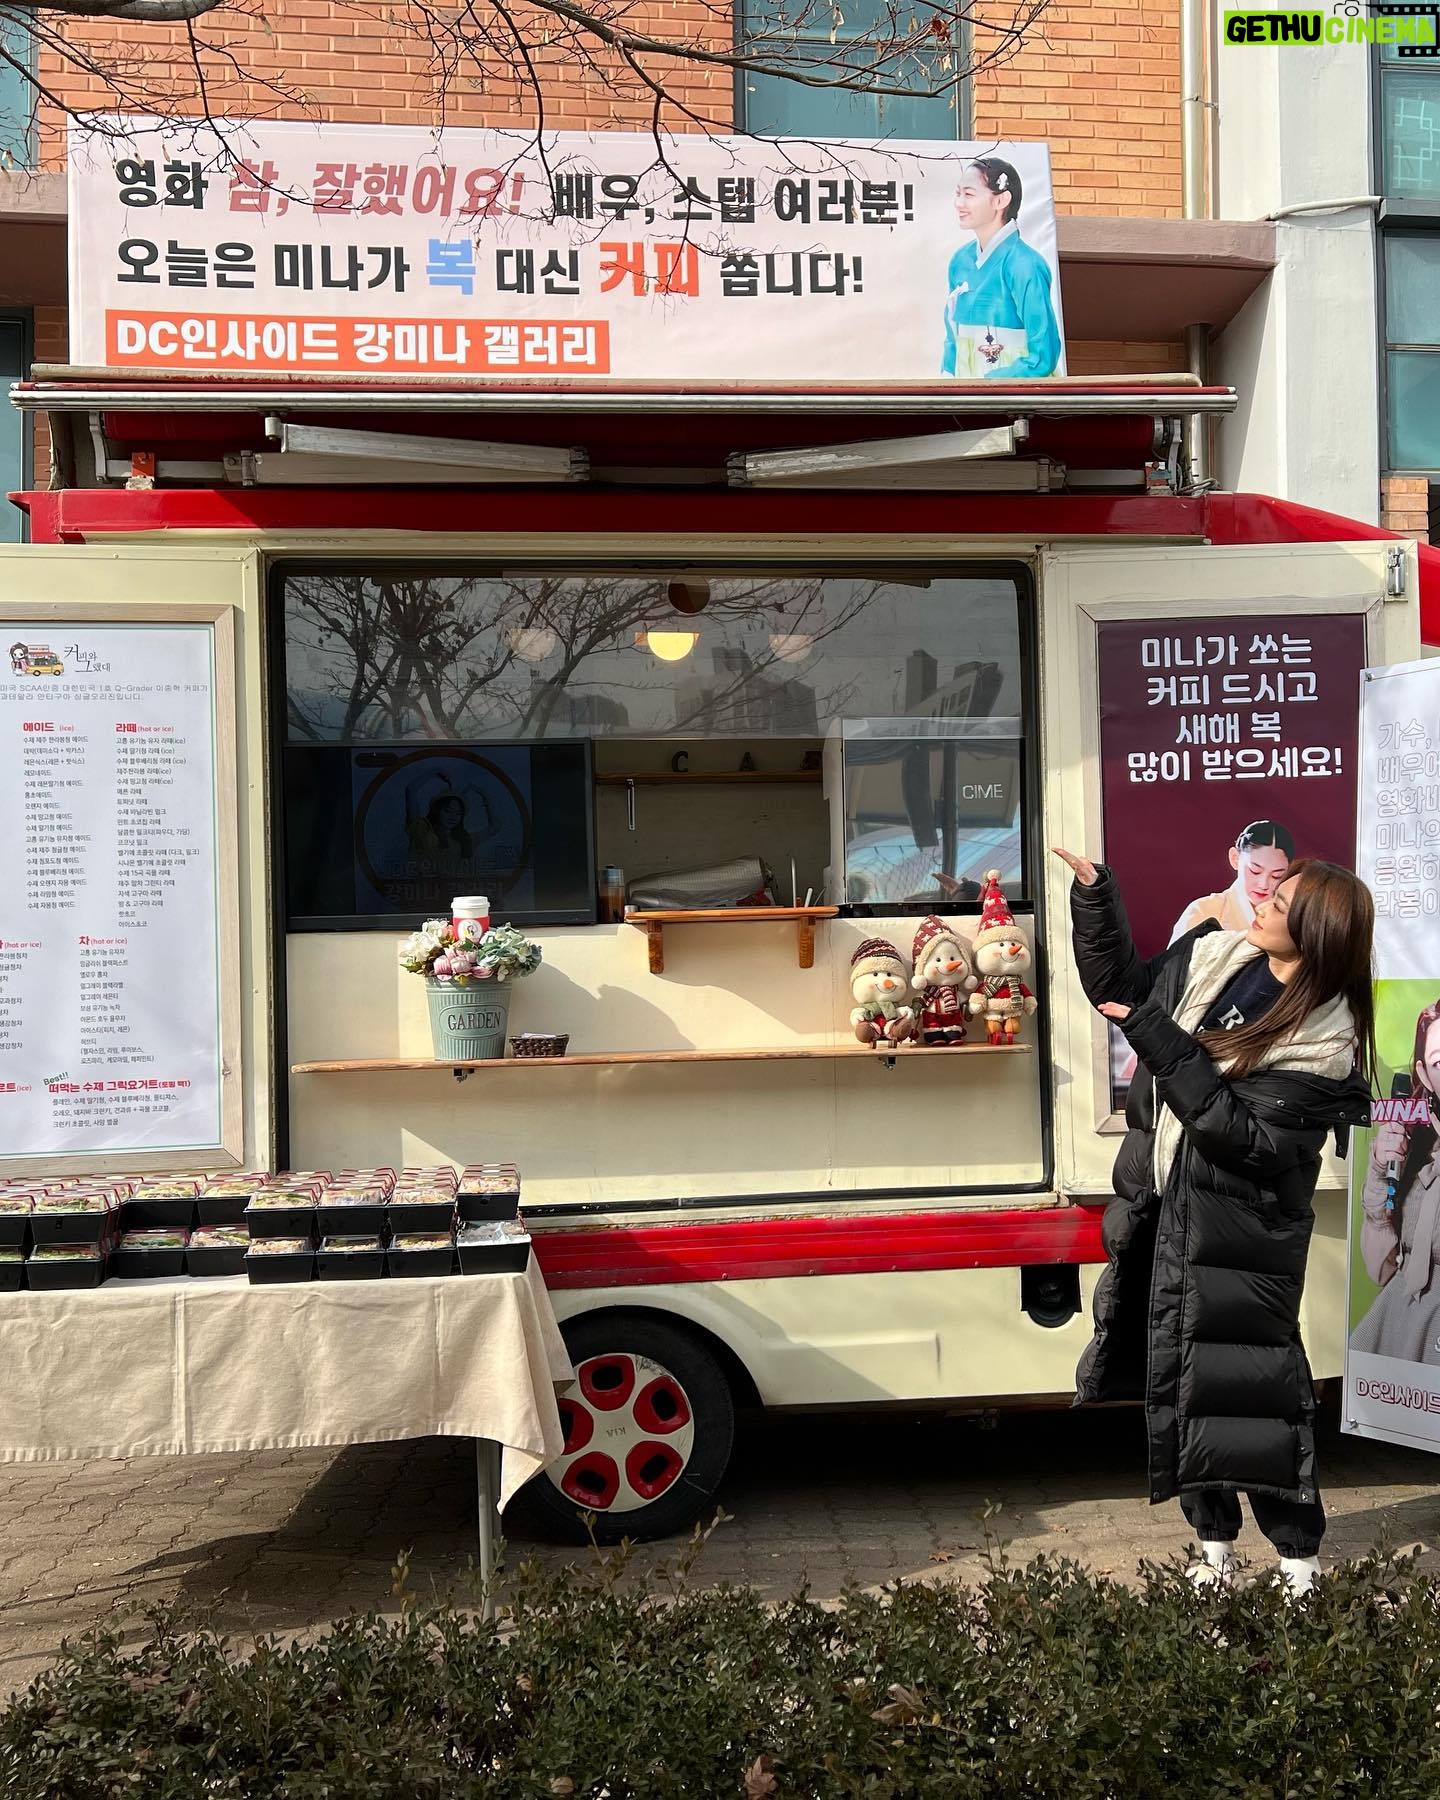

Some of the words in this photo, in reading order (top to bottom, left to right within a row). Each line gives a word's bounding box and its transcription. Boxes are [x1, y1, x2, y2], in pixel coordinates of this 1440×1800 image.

[116, 158, 209, 209] 영화
[229, 158, 290, 217] 참,
[312, 161, 526, 217] 잘했어요!
[553, 173, 654, 225] 배우,
[673, 175, 755, 225] 스텝
[775, 179, 914, 225] 여러분!
[117, 238, 257, 289] 오늘은
[274, 244, 410, 293] 미나가
[426, 238, 476, 295] 복
[496, 248, 580, 295] 대신
[600, 242, 700, 297] 커피
[720, 252, 863, 297] 쏩니다!
[117, 318, 340, 362] DC인사이드
[353, 323, 471, 364] 강미나
[484, 326, 597, 367] 갤러리
[1141, 634, 1239, 668] 미나가
[1248, 633, 1312, 665] 쏘는
[1147, 674, 1210, 706] 커피
[1221, 671, 1318, 705] 드시고
[23, 722, 55, 732] 에이드
[116, 723, 137, 732] 라떼
[1176, 712, 1240, 745] 새해
[1251, 711, 1281, 742] 복
[1378, 719, 1433, 750] 가수,
[1127, 750, 1191, 783] 많이
[1202, 746, 1342, 781] 받으세요!
[79, 936, 90, 945] 차
[447, 1011, 501, 1031] GARDEN
[43, 1072, 69, 1086] Best!!
[49, 1083, 80, 1093] 떠먹는
[83, 1082, 104, 1092] 수제
[1370, 1099, 1430, 1124] MINA
[1356, 1377, 1440, 1415] DC인사이드
